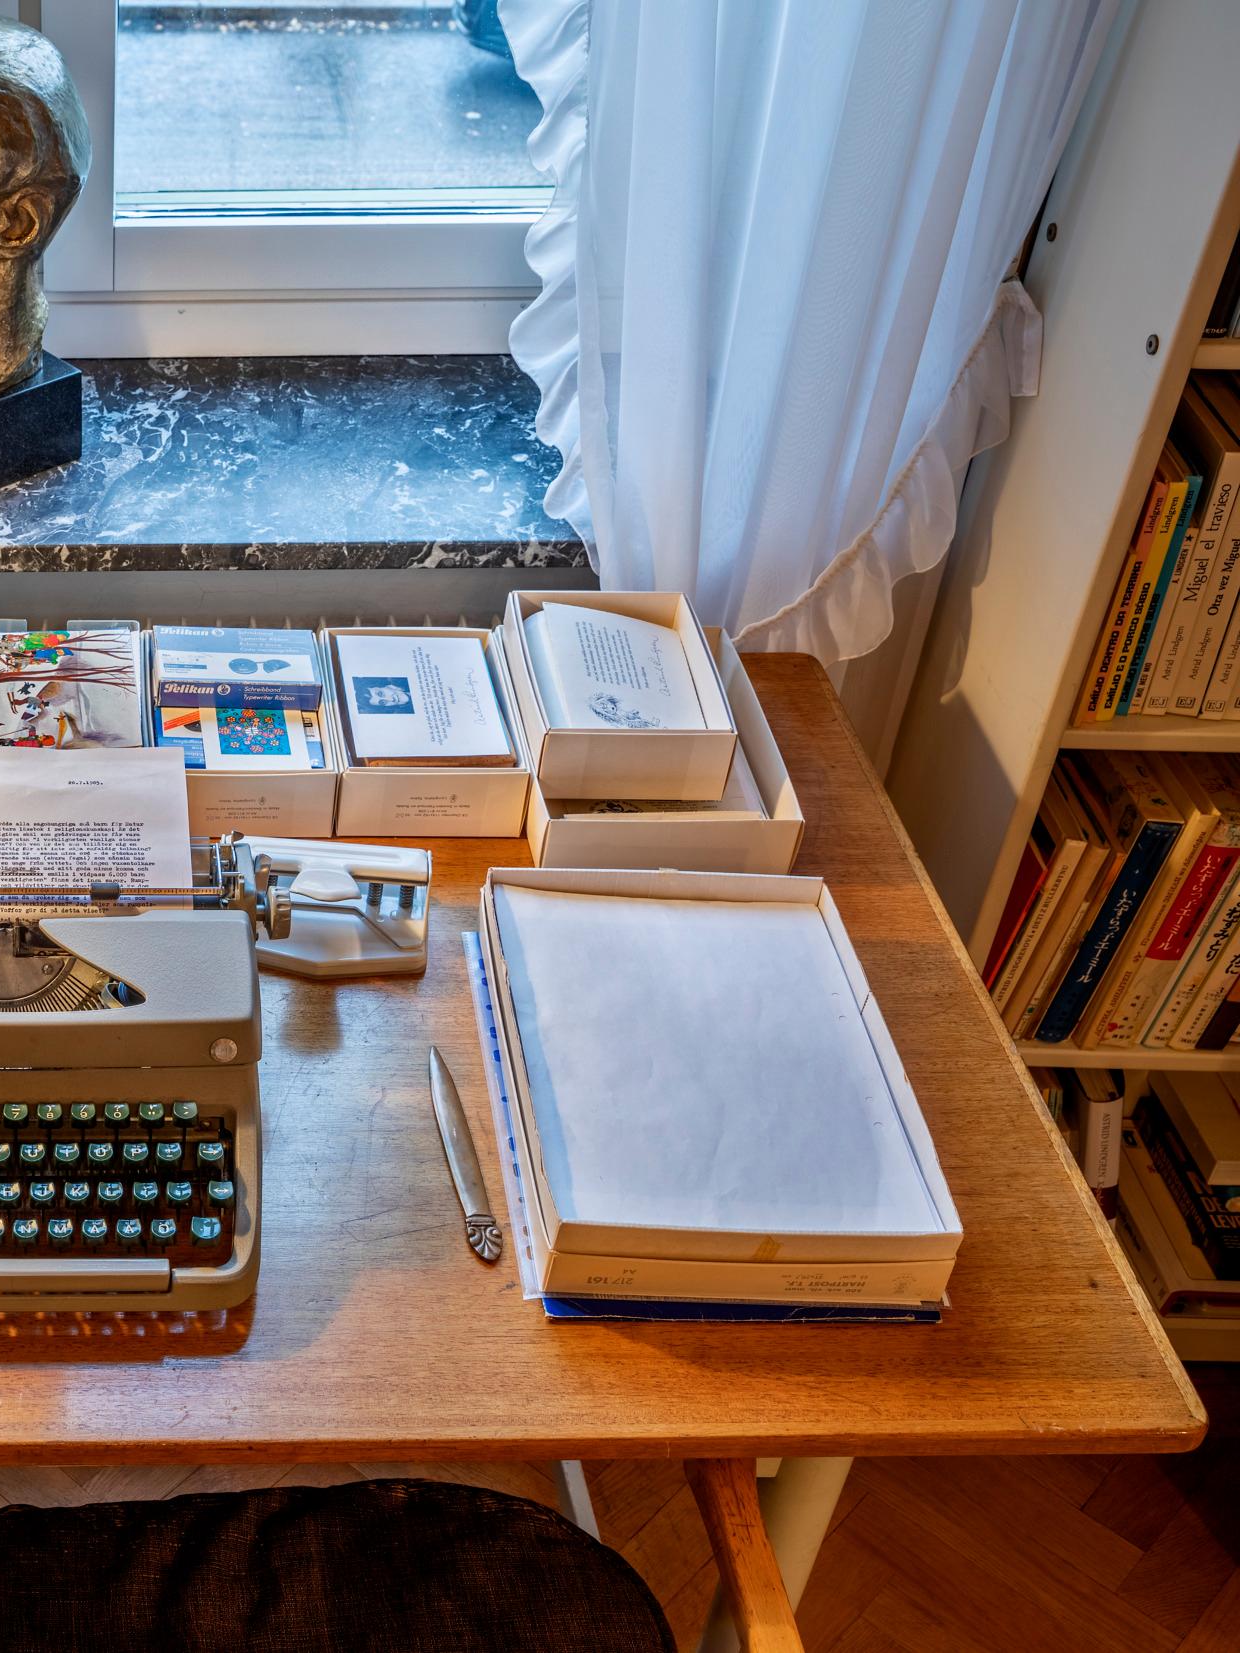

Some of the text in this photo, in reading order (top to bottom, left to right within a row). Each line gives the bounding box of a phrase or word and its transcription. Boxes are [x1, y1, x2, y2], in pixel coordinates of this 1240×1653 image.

[1144, 497, 1163, 535] Lindgren
[1160, 496, 1179, 535] Lindgren
[1183, 483, 1232, 602] Miguel el travieso
[1207, 593, 1224, 618] Otra
[1217, 575, 1230, 592] vez
[160, 627, 209, 636] Pelikan
[1100, 631, 1120, 673] DENTRO
[1115, 610, 1127, 627] DA
[1122, 617, 1139, 653] PORCO
[1161, 625, 1184, 680] Astrid Lindgren
[1188, 627, 1213, 679] Astrid Lindgren
[163, 683, 214, 694] Pelikan
[1100, 1112, 1111, 1139] ASTRID
[1096, 1139, 1109, 1177] LINDGREN
[1201, 1196, 1224, 1213] DE
[586, 1276, 609, 1285] 161
